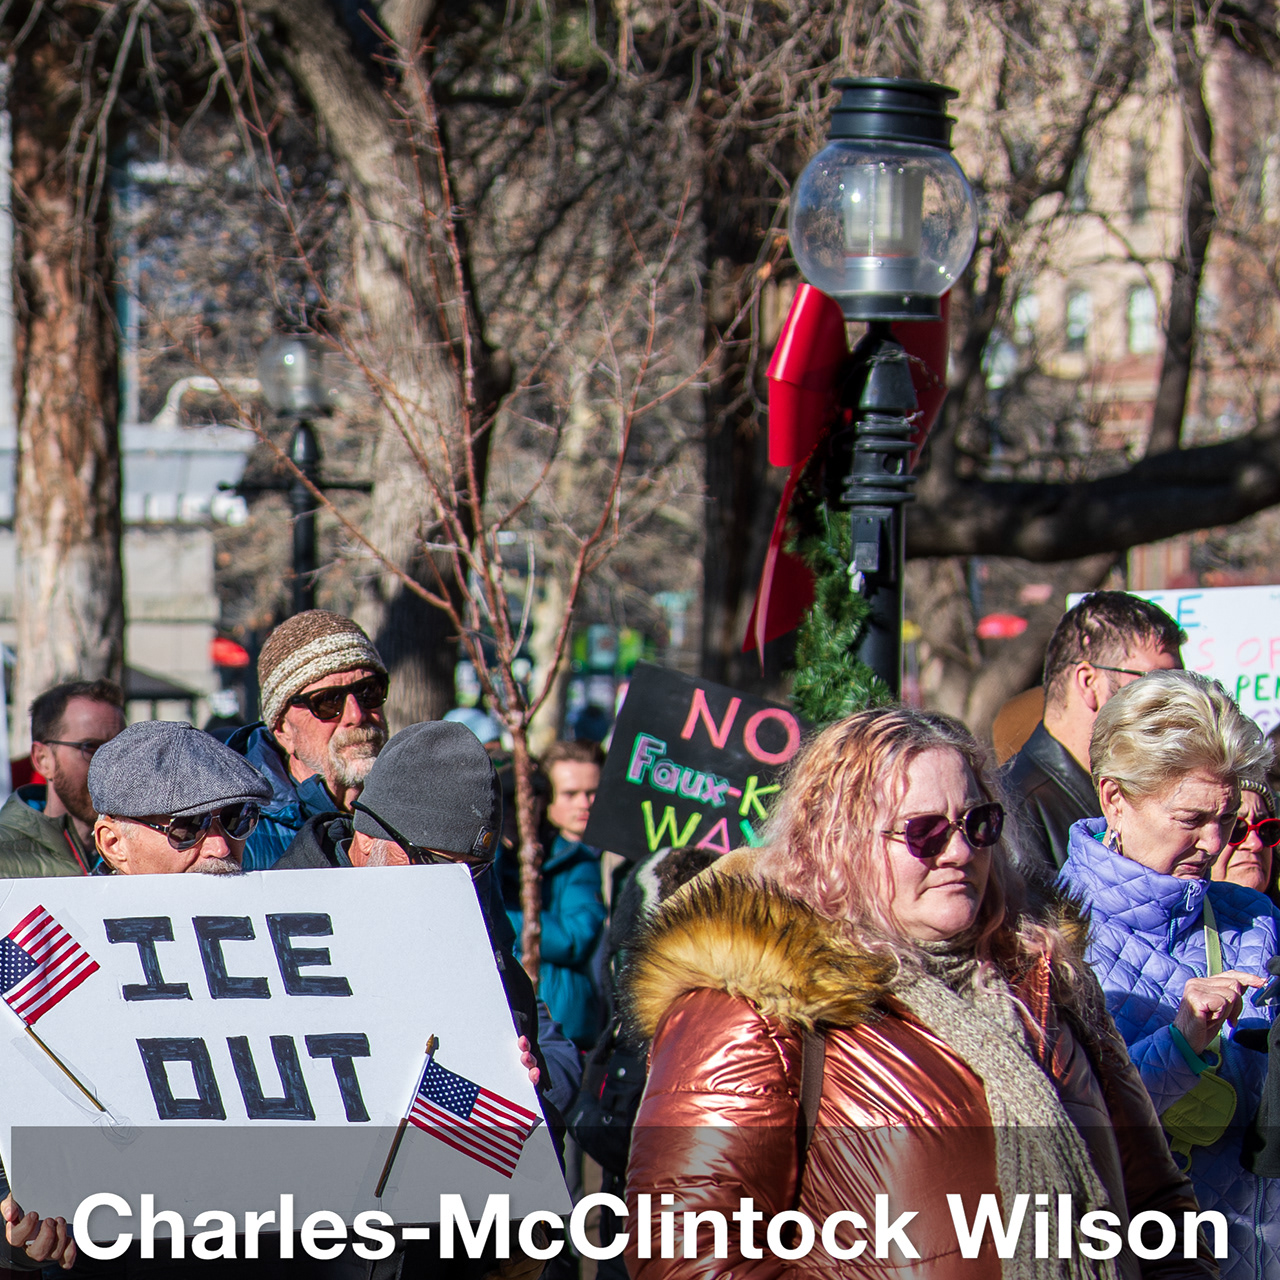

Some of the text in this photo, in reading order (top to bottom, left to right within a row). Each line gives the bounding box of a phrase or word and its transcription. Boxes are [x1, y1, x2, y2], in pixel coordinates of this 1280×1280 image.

[681, 688, 800, 766] NO
[103, 913, 353, 1001] ICE
[135, 1033, 371, 1122] OUT
